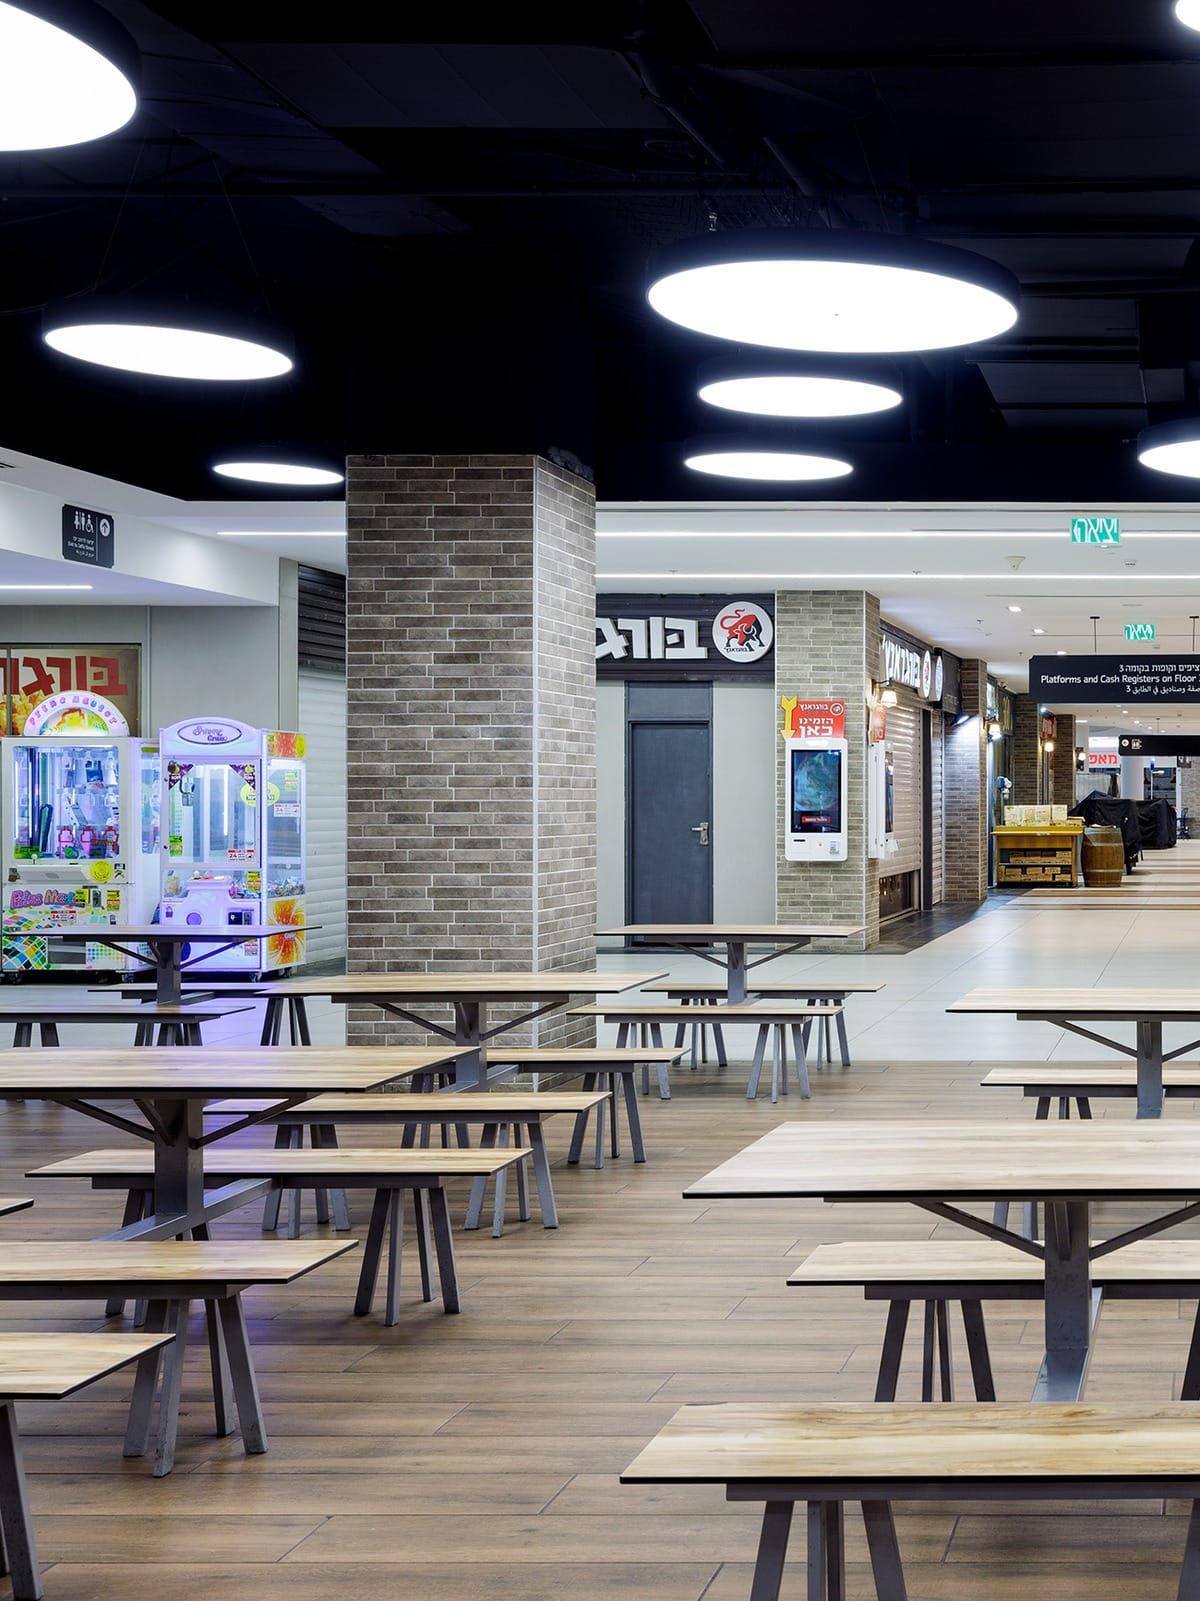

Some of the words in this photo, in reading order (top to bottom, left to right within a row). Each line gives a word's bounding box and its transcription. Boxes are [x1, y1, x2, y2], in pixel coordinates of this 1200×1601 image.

[1077, 518, 1118, 543] יציאה
[1119, 664, 1124, 672] 3
[1125, 664, 1150, 674] בקומה
[1151, 664, 1177, 674] וקופות
[1040, 674, 1082, 683] Platforms
[1083, 674, 1099, 683] and
[1100, 674, 1120, 683] Cash
[1122, 674, 1160, 685] Registers
[1174, 674, 1197, 683] Floor
[1126, 685, 1131, 693] 3
[1152, 685, 1159, 695] في
[1160, 685, 1186, 695] وصناديق
[799, 717, 834, 725] הזמינו
[799, 725, 833, 738] כאן
